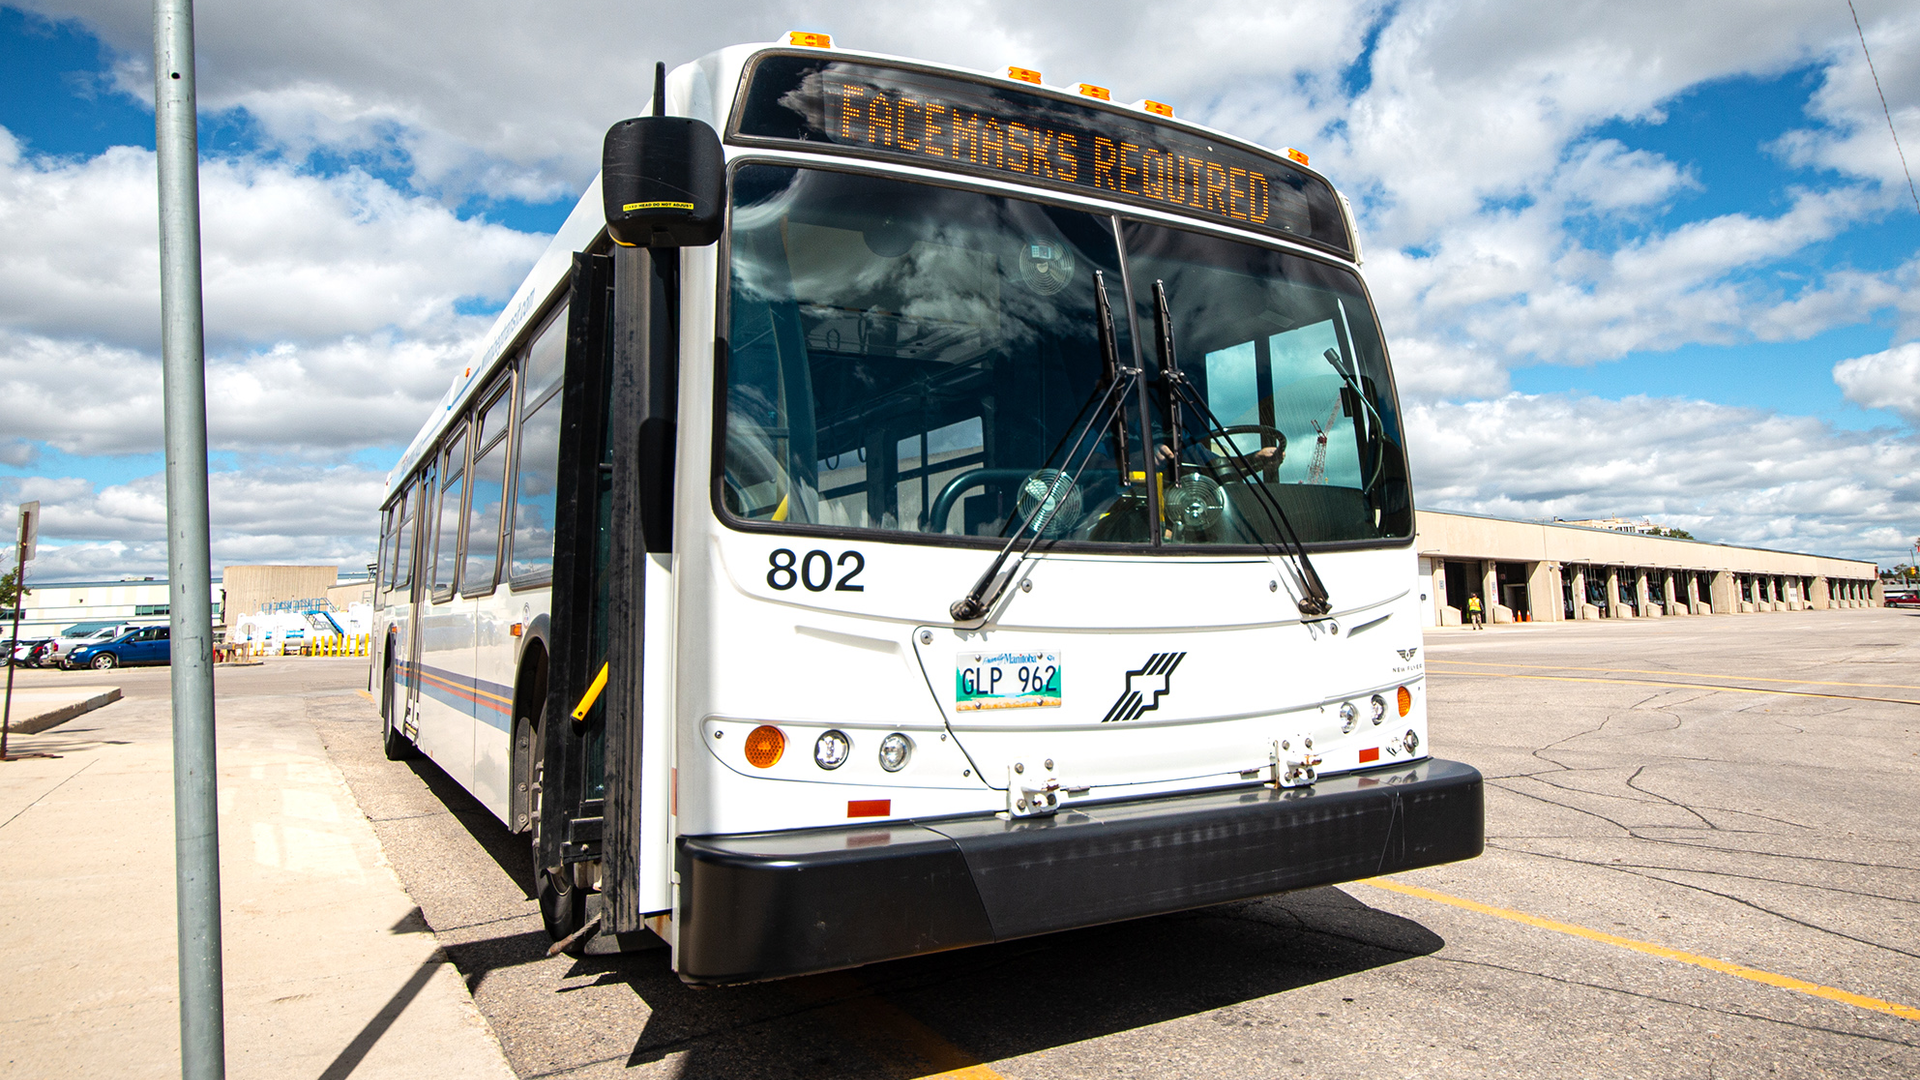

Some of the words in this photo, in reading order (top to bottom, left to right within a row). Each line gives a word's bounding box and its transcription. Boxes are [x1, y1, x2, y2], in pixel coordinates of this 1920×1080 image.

[841, 84, 1079, 183] FACEMASKS
[1094, 135, 1270, 224] REQUIRED
[766, 548, 865, 592] 802
[1004, 653, 1037, 664] Manitoba
[1407, 663, 1422, 671] FLYER
[962, 666, 1003, 695] GLP
[1018, 665, 1057, 692] 962
